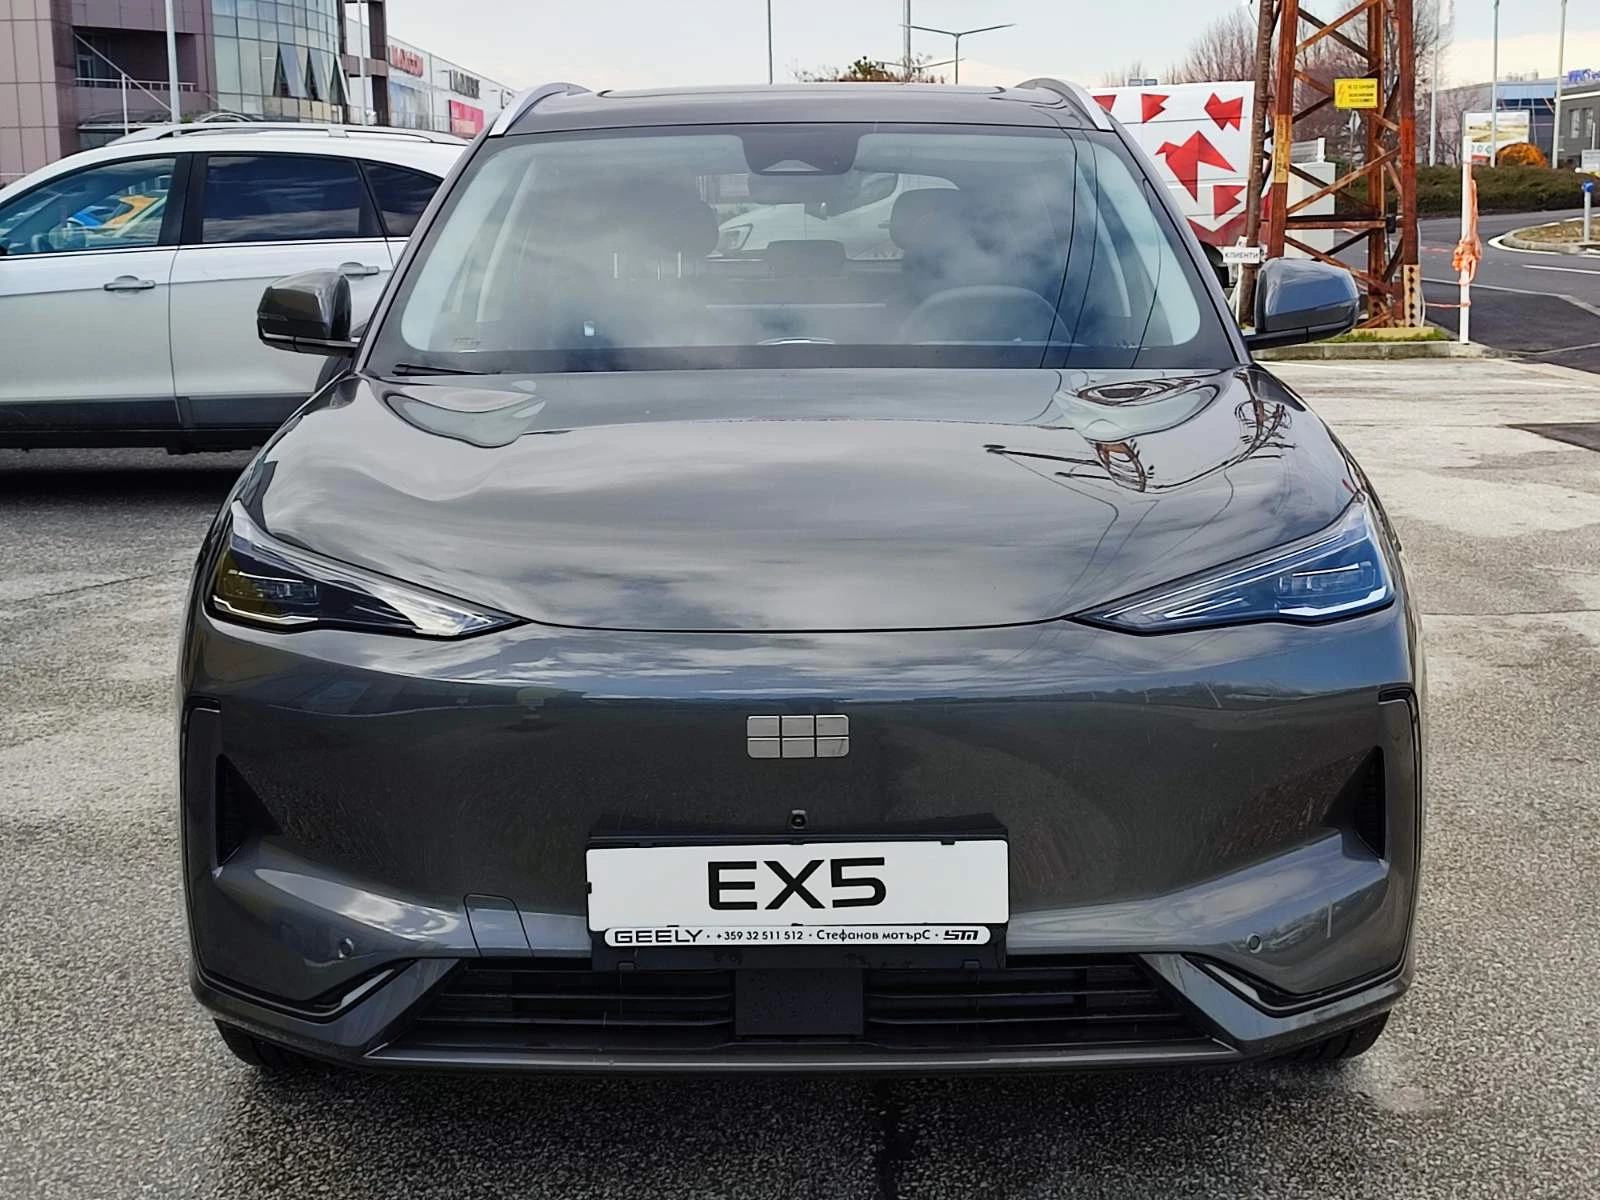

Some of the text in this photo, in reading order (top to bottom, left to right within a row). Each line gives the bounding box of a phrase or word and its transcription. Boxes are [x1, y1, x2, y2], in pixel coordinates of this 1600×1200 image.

[708, 857, 886, 910] EX5
[615, 929, 703, 943] GEELY
[717, 931, 743, 940] +359
[746, 931, 758, 940] 32
[762, 931, 779, 940] 511
[784, 931, 803, 940] 512
[817, 929, 878, 942] Стефанов
